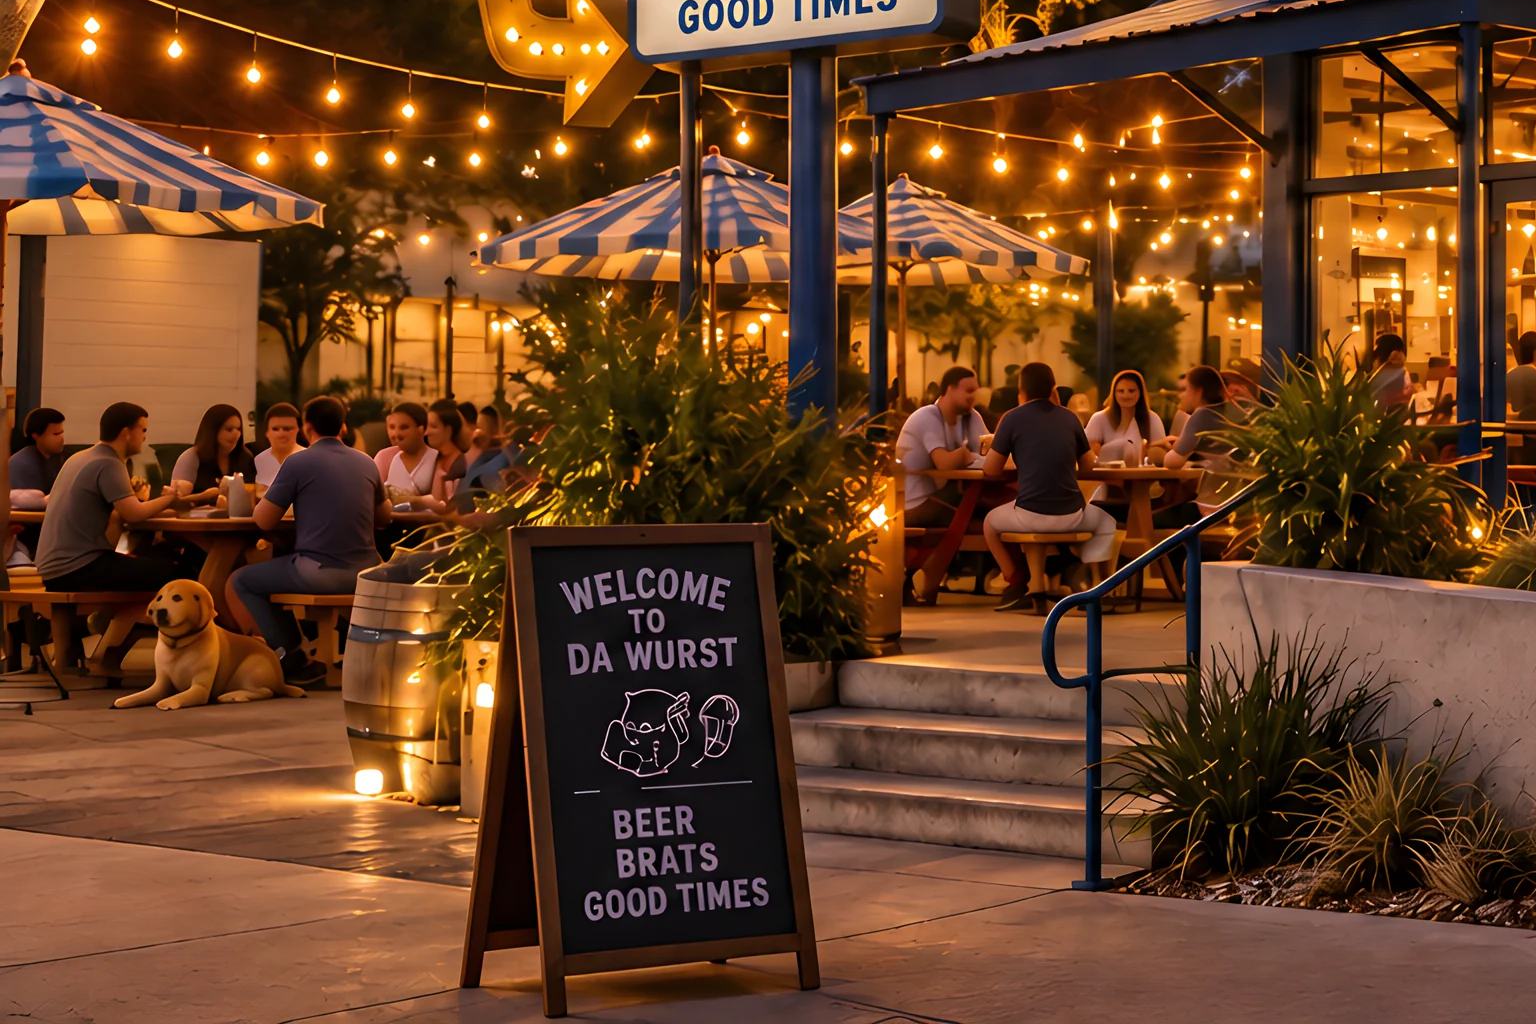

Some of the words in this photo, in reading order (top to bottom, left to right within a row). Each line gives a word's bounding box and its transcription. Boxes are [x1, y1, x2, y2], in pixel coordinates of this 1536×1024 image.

[558, 567, 731, 615] WELCOME
[627, 608, 666, 634] TO
[567, 643, 614, 675] DA
[623, 637, 738, 671] WURST
[613, 805, 696, 840] BEER
[616, 842, 719, 878] BRATS
[584, 886, 667, 921] GOOD
[676, 877, 770, 911] TIMES
